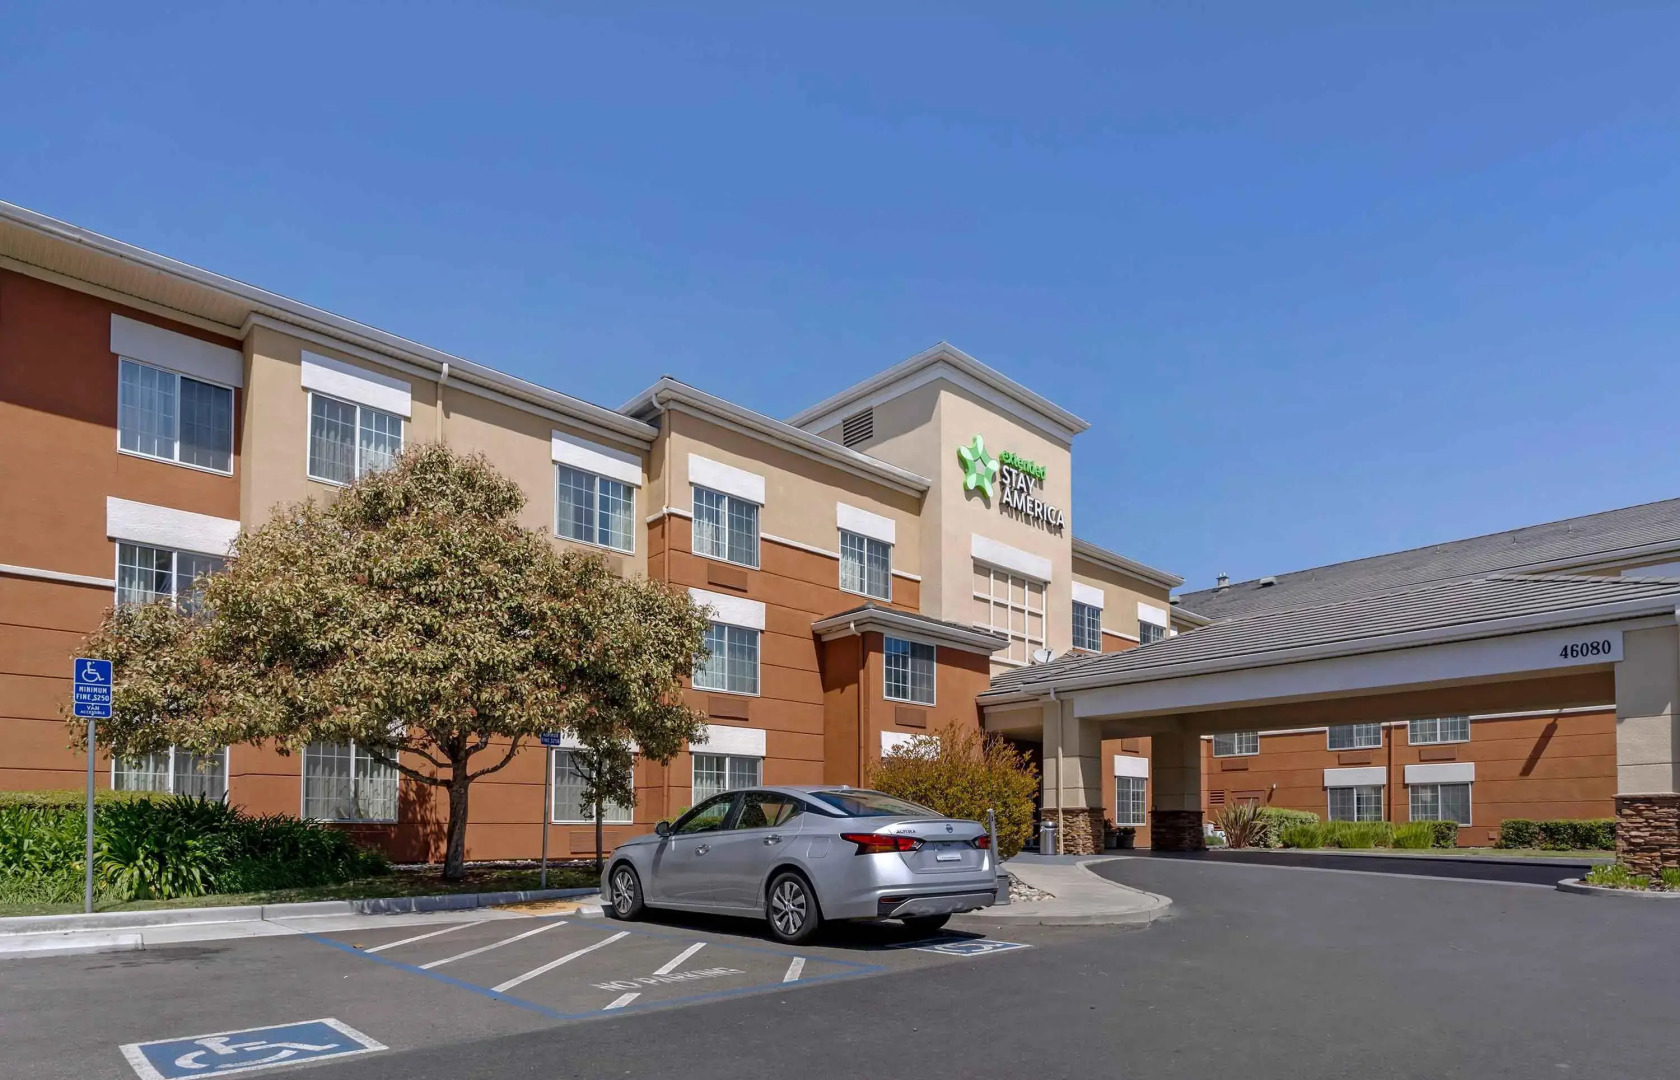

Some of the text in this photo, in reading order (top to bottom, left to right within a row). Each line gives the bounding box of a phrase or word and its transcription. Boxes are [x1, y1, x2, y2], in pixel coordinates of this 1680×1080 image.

[1000, 450, 1047, 481] extended
[1002, 464, 1035, 496] STAY
[1002, 486, 1066, 528] AMERICA
[1559, 639, 1612, 659] 46080
[79, 686, 108, 694] MINIMUM
